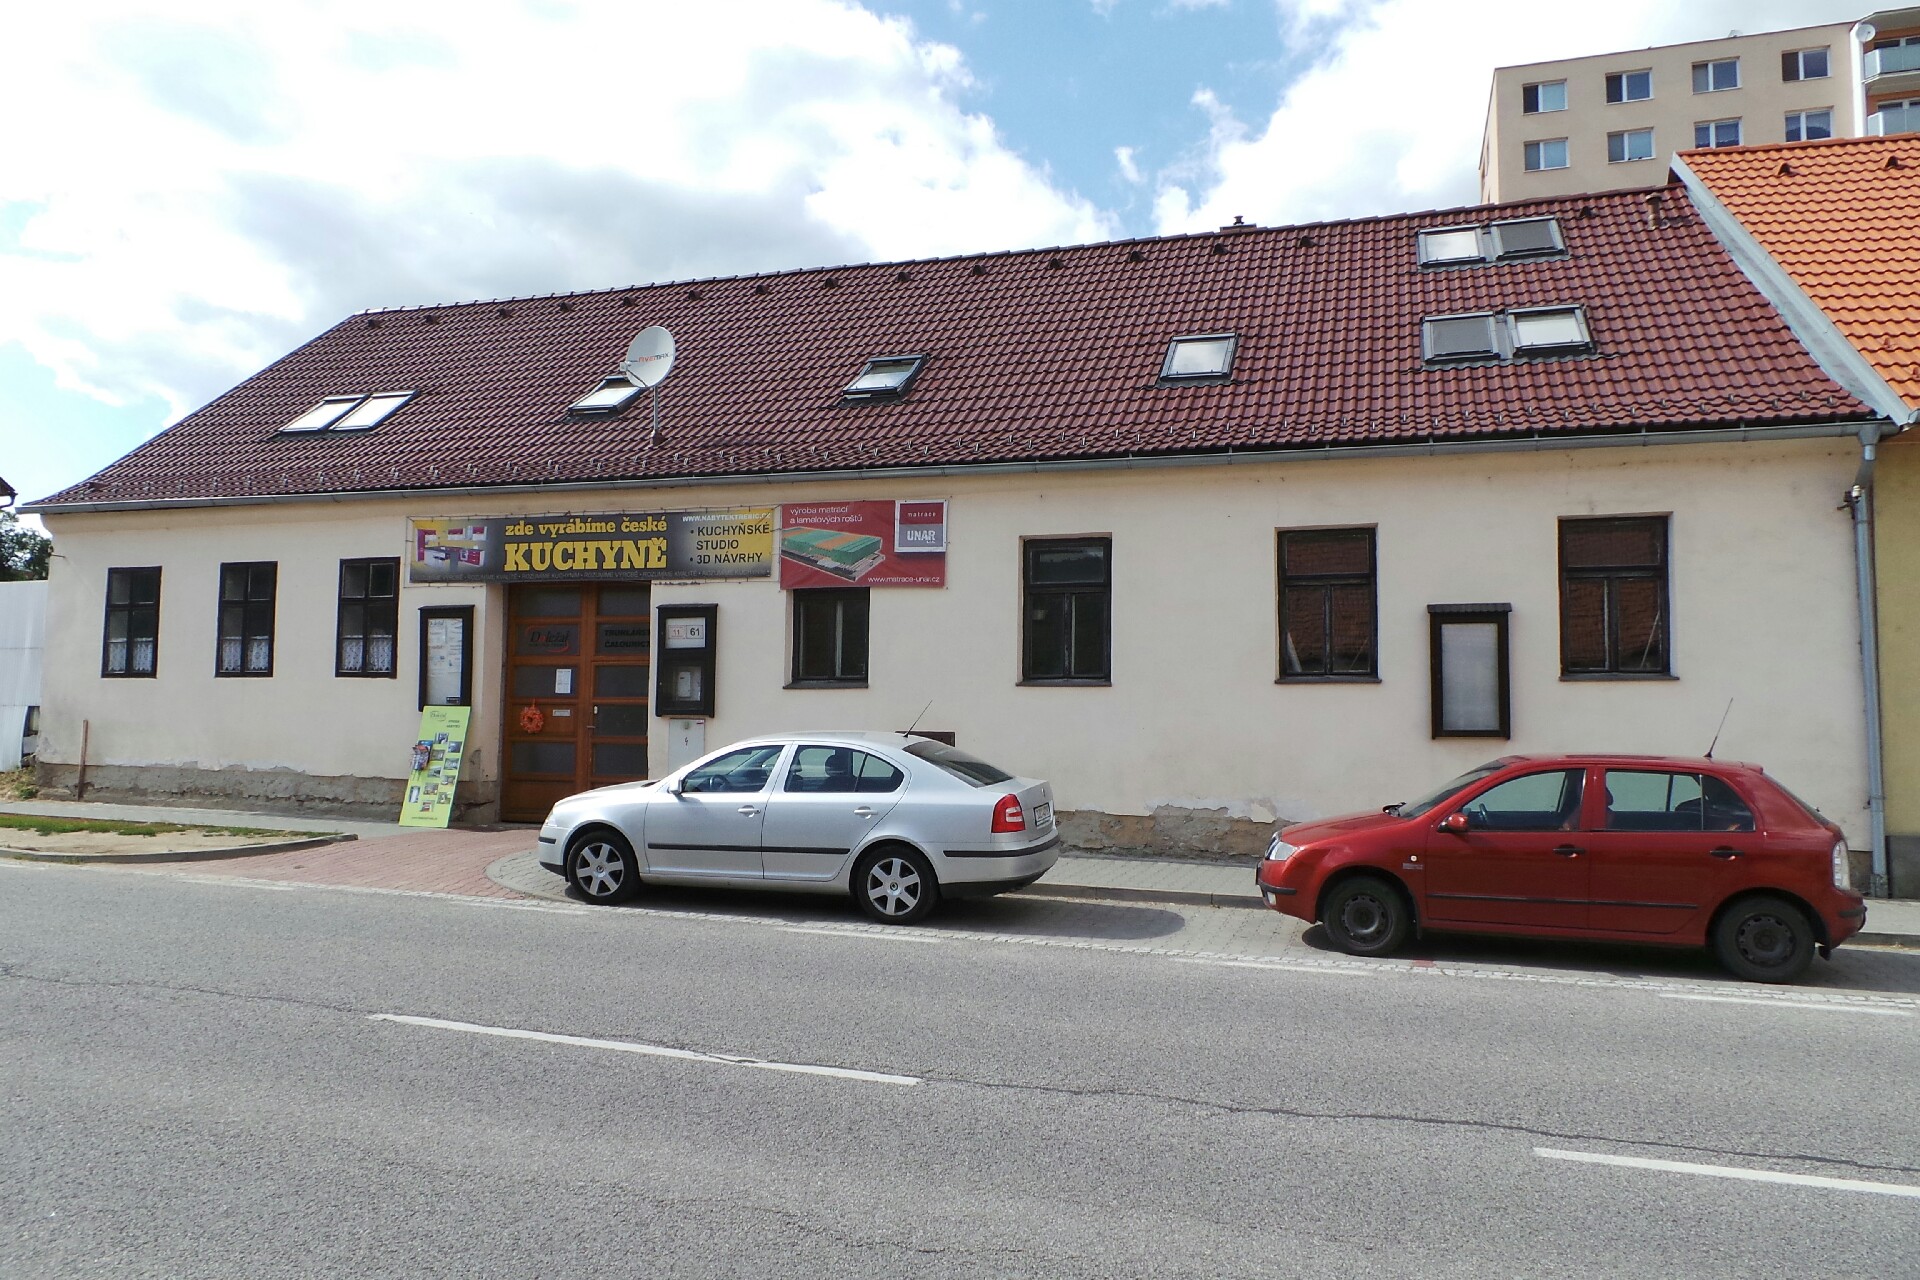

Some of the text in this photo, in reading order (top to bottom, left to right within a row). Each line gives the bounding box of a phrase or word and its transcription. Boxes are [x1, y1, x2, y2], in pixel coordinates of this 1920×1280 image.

[790, 504, 848, 516] výroba matrací
[841, 514, 863, 523] roštů
[505, 515, 668, 538] zde vyrábíme české
[697, 521, 770, 536] KUCHYŇSKÉ
[906, 530, 936, 541] UNAR
[696, 539, 739, 551] STUDIO
[503, 537, 667, 572] KUCHYNĚ
[696, 550, 763, 565] 3D NÁVRHY
[689, 627, 700, 637] 61
